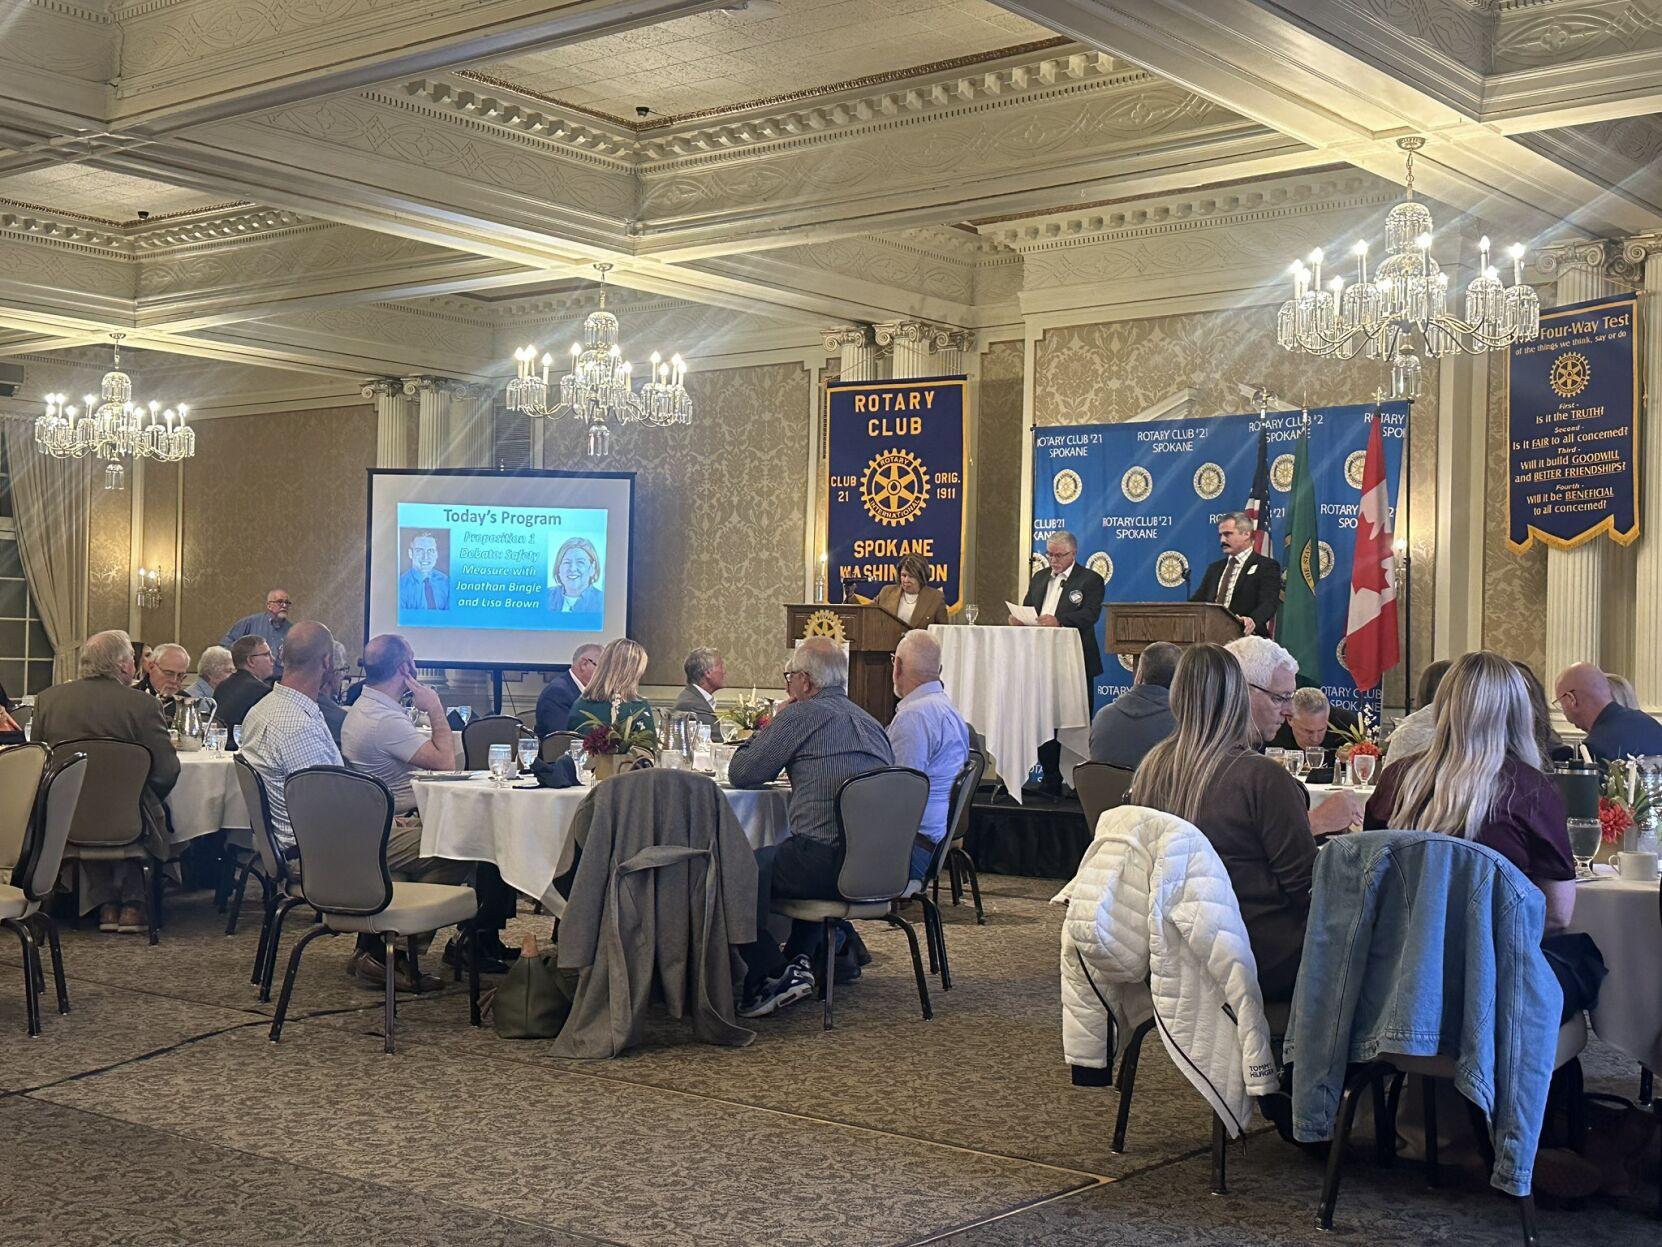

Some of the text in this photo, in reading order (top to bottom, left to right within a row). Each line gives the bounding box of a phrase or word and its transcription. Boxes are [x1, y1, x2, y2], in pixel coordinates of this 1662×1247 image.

[1540, 320, 1599, 340] Four-Way
[1602, 313, 1630, 329] Test
[1524, 346, 1536, 354] the
[1537, 342, 1559, 352] things
[1560, 340, 1571, 348] we
[1595, 334, 1607, 343] say
[1608, 332, 1617, 340] or
[1618, 330, 1627, 338] do
[854, 391, 935, 413] ROTARY
[1536, 416, 1543, 424] Is
[1545, 414, 1551, 423] it
[1553, 411, 1568, 420] the
[868, 417, 922, 437] CLUB
[1248, 418, 1284, 432] ROARY
[1554, 425, 1580, 433] Second
[1137, 430, 1170, 441] ROTARY
[1171, 429, 1195, 440] CLUB
[1382, 427, 1404, 438] SPO
[1512, 426, 1628, 450] Is it FAIR to all concerned?
[1066, 434, 1089, 445] CLUB
[1049, 446, 1088, 458] SPOKANE
[1152, 441, 1194, 453] SPOKANE
[880, 456, 909, 466] ROTARY
[1520, 450, 1620, 470] Will it build GOODWILL
[830, 475, 857, 487] CLUB
[934, 472, 961, 484] ORIG.
[1514, 472, 1532, 483] and
[1533, 469, 1562, 482] BETTER
[936, 487, 956, 499] 1911
[1555, 483, 1580, 491] Fourth
[838, 491, 849, 502] 21
[1526, 487, 1614, 504] Will it be BENEFICIAL
[870, 499, 920, 518] INTERNATIONAL
[1320, 504, 1359, 516] ROTARY
[1533, 507, 1541, 516] to
[1542, 504, 1552, 514] all
[444, 508, 562, 528] Today’s Program
[1034, 519, 1057, 529] CLUB
[1135, 516, 1158, 526] CLUB
[1338, 517, 1358, 528] SPO
[463, 531, 536, 545] Proposition 1
[1116, 528, 1158, 539] SPOKANE
[854, 539, 933, 558] SPOKANE
[504, 549, 540, 562] Safety
[462, 564, 536, 576] Measure with
[839, 563, 948, 583] WASHINON
[456, 581, 542, 594] Jonathan Bingle
[458, 598, 540, 609] and Lisa Brown
[1320, 685, 1382, 700] OTARY CUB
